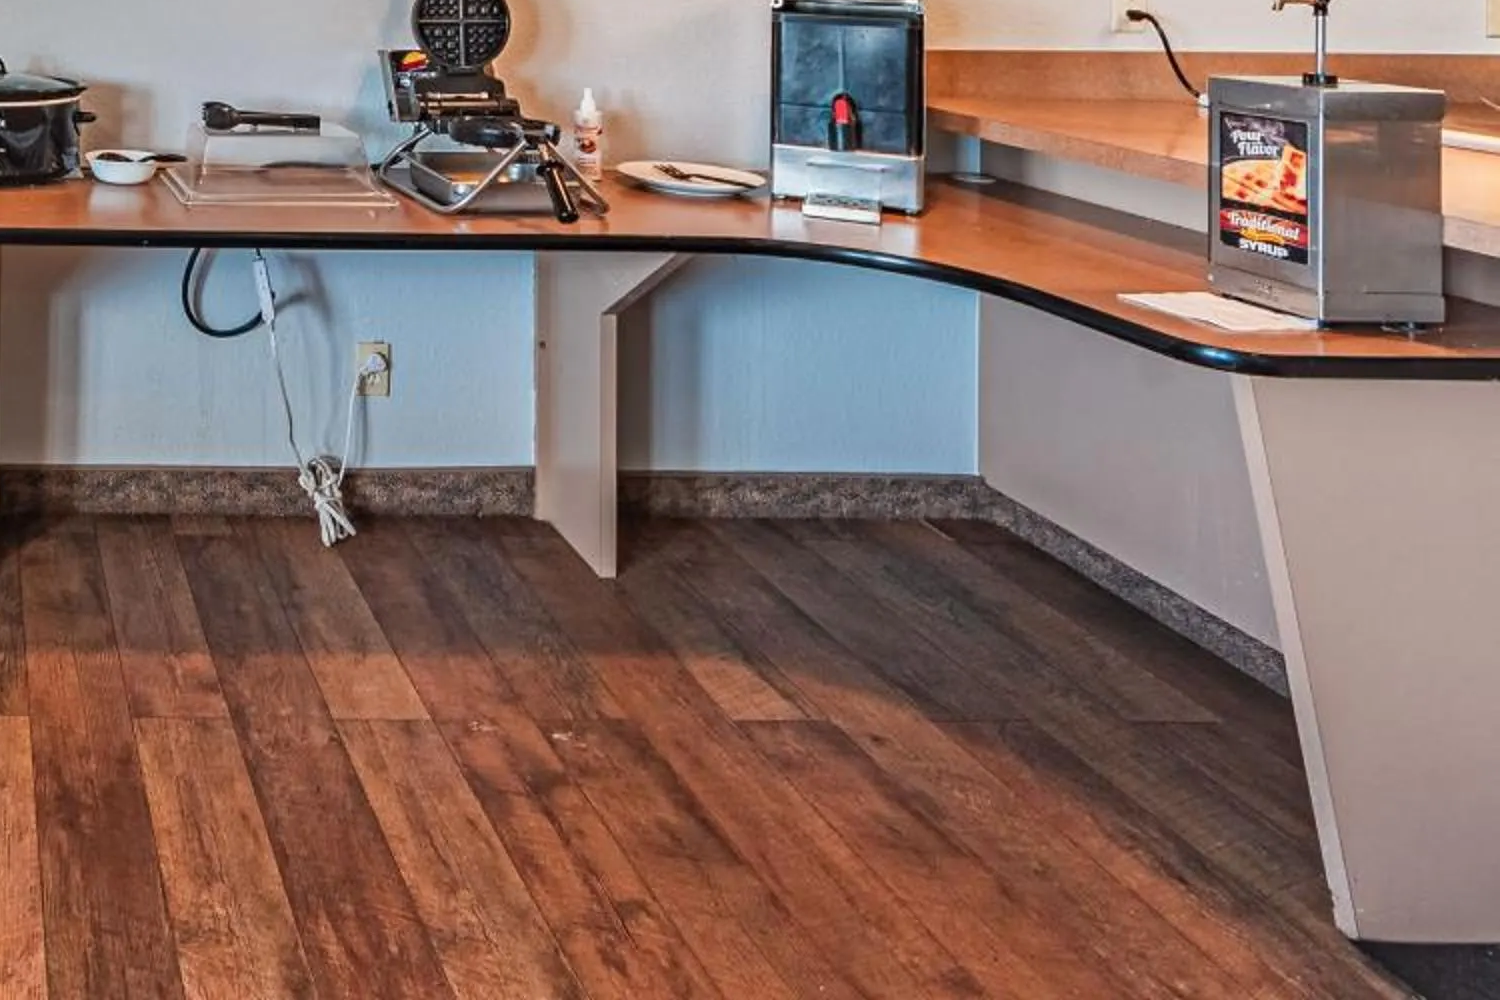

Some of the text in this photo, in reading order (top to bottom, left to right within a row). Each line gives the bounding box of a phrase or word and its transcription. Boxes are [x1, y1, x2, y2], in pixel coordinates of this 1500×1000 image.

[1237, 141, 1280, 157] Flavor
[1228, 212, 1300, 239] Traditional
[1238, 237, 1290, 258] SYRUP
